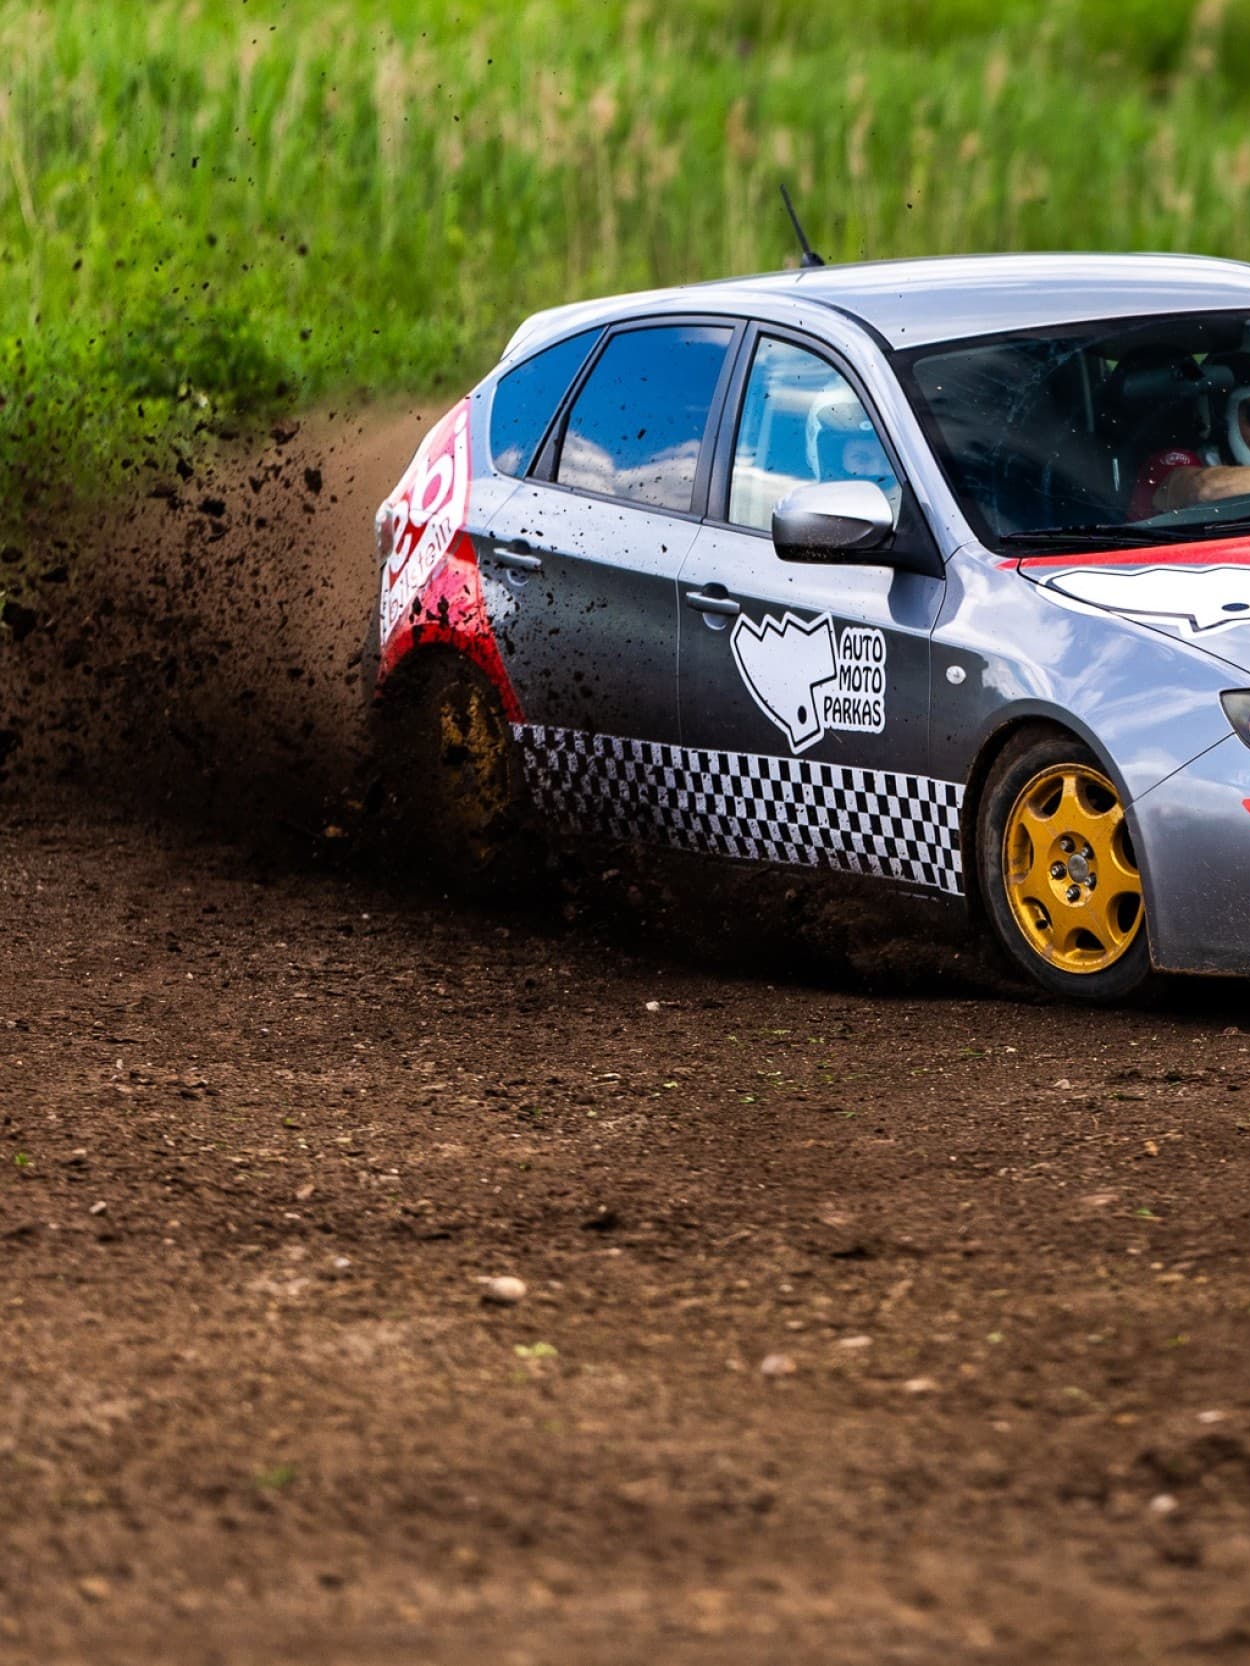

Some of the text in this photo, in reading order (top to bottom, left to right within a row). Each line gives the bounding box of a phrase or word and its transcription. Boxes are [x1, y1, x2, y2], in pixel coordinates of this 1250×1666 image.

[843, 634, 883, 662] AUTO
[839, 665, 882, 693] MOTO
[824, 696, 882, 726] PARKAS
